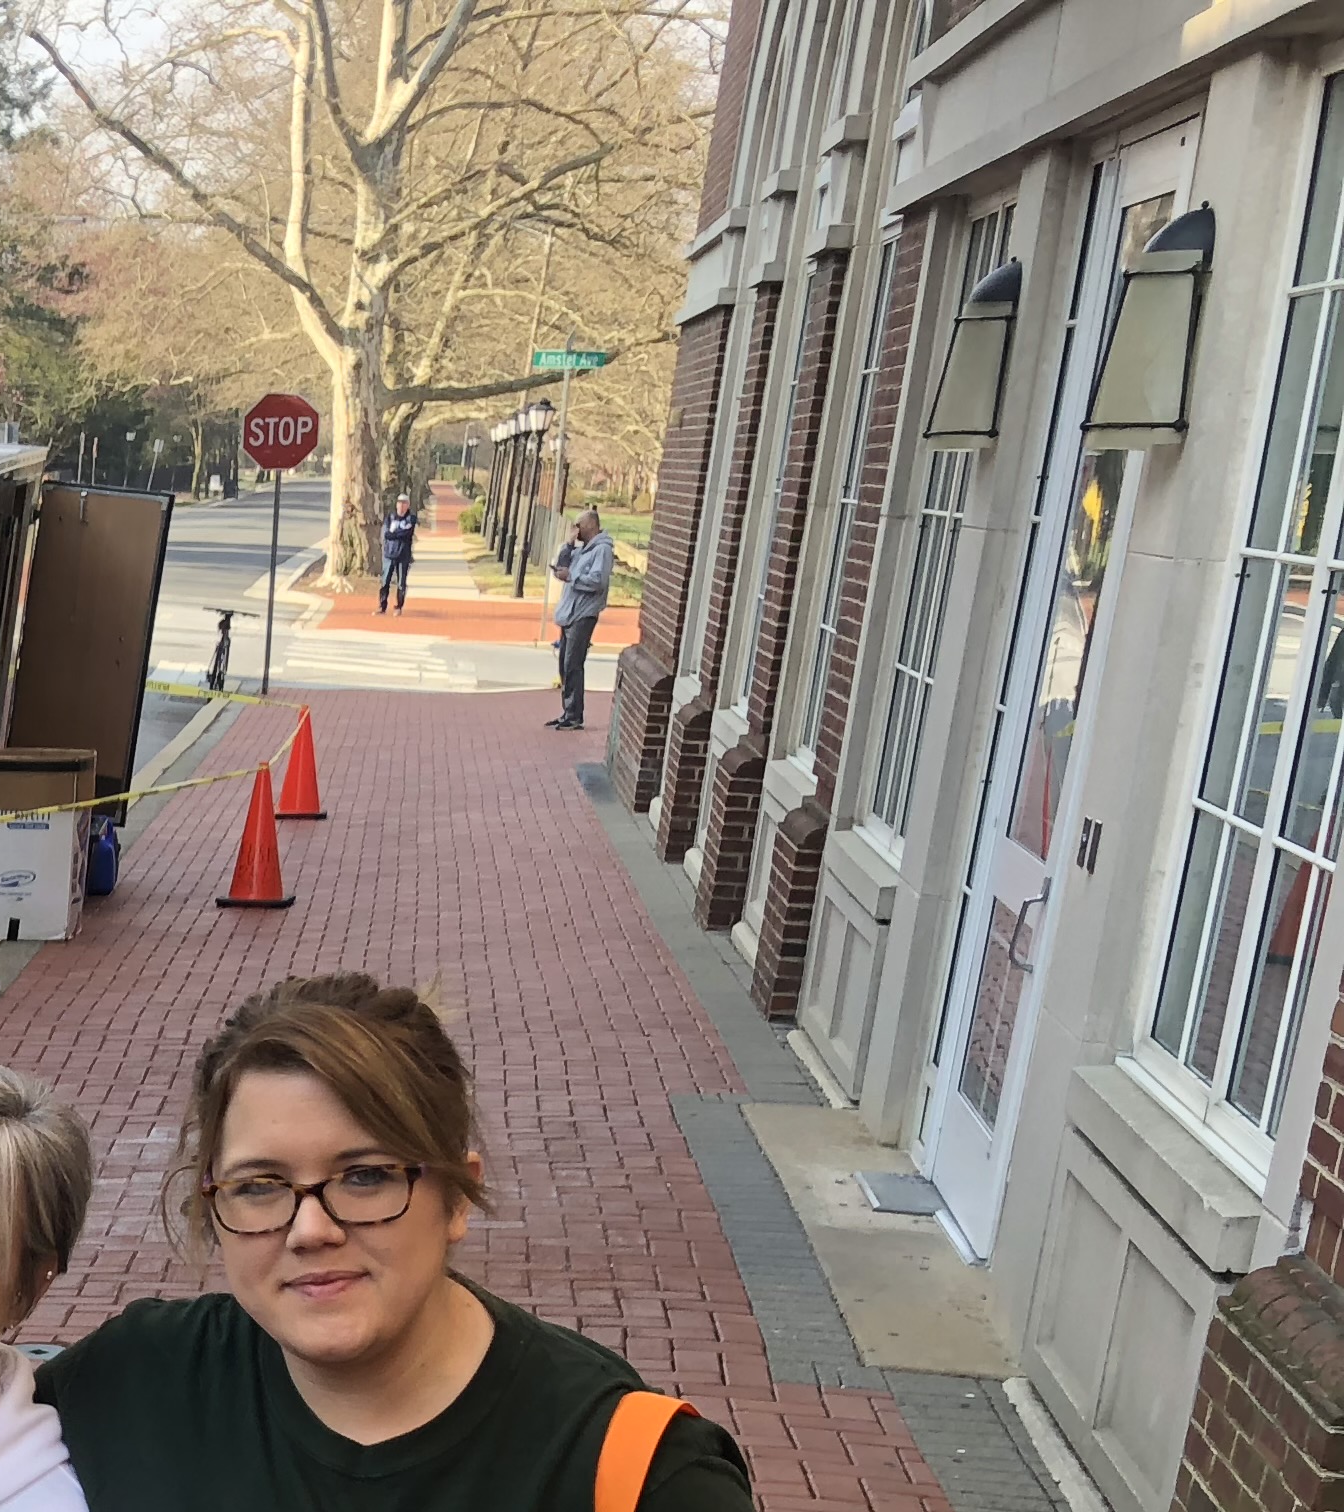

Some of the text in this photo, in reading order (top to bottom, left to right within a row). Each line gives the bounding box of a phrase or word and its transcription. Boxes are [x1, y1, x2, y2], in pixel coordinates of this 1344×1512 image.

[539, 353, 599, 366] Amstel Ave
[248, 416, 313, 447] STOP
